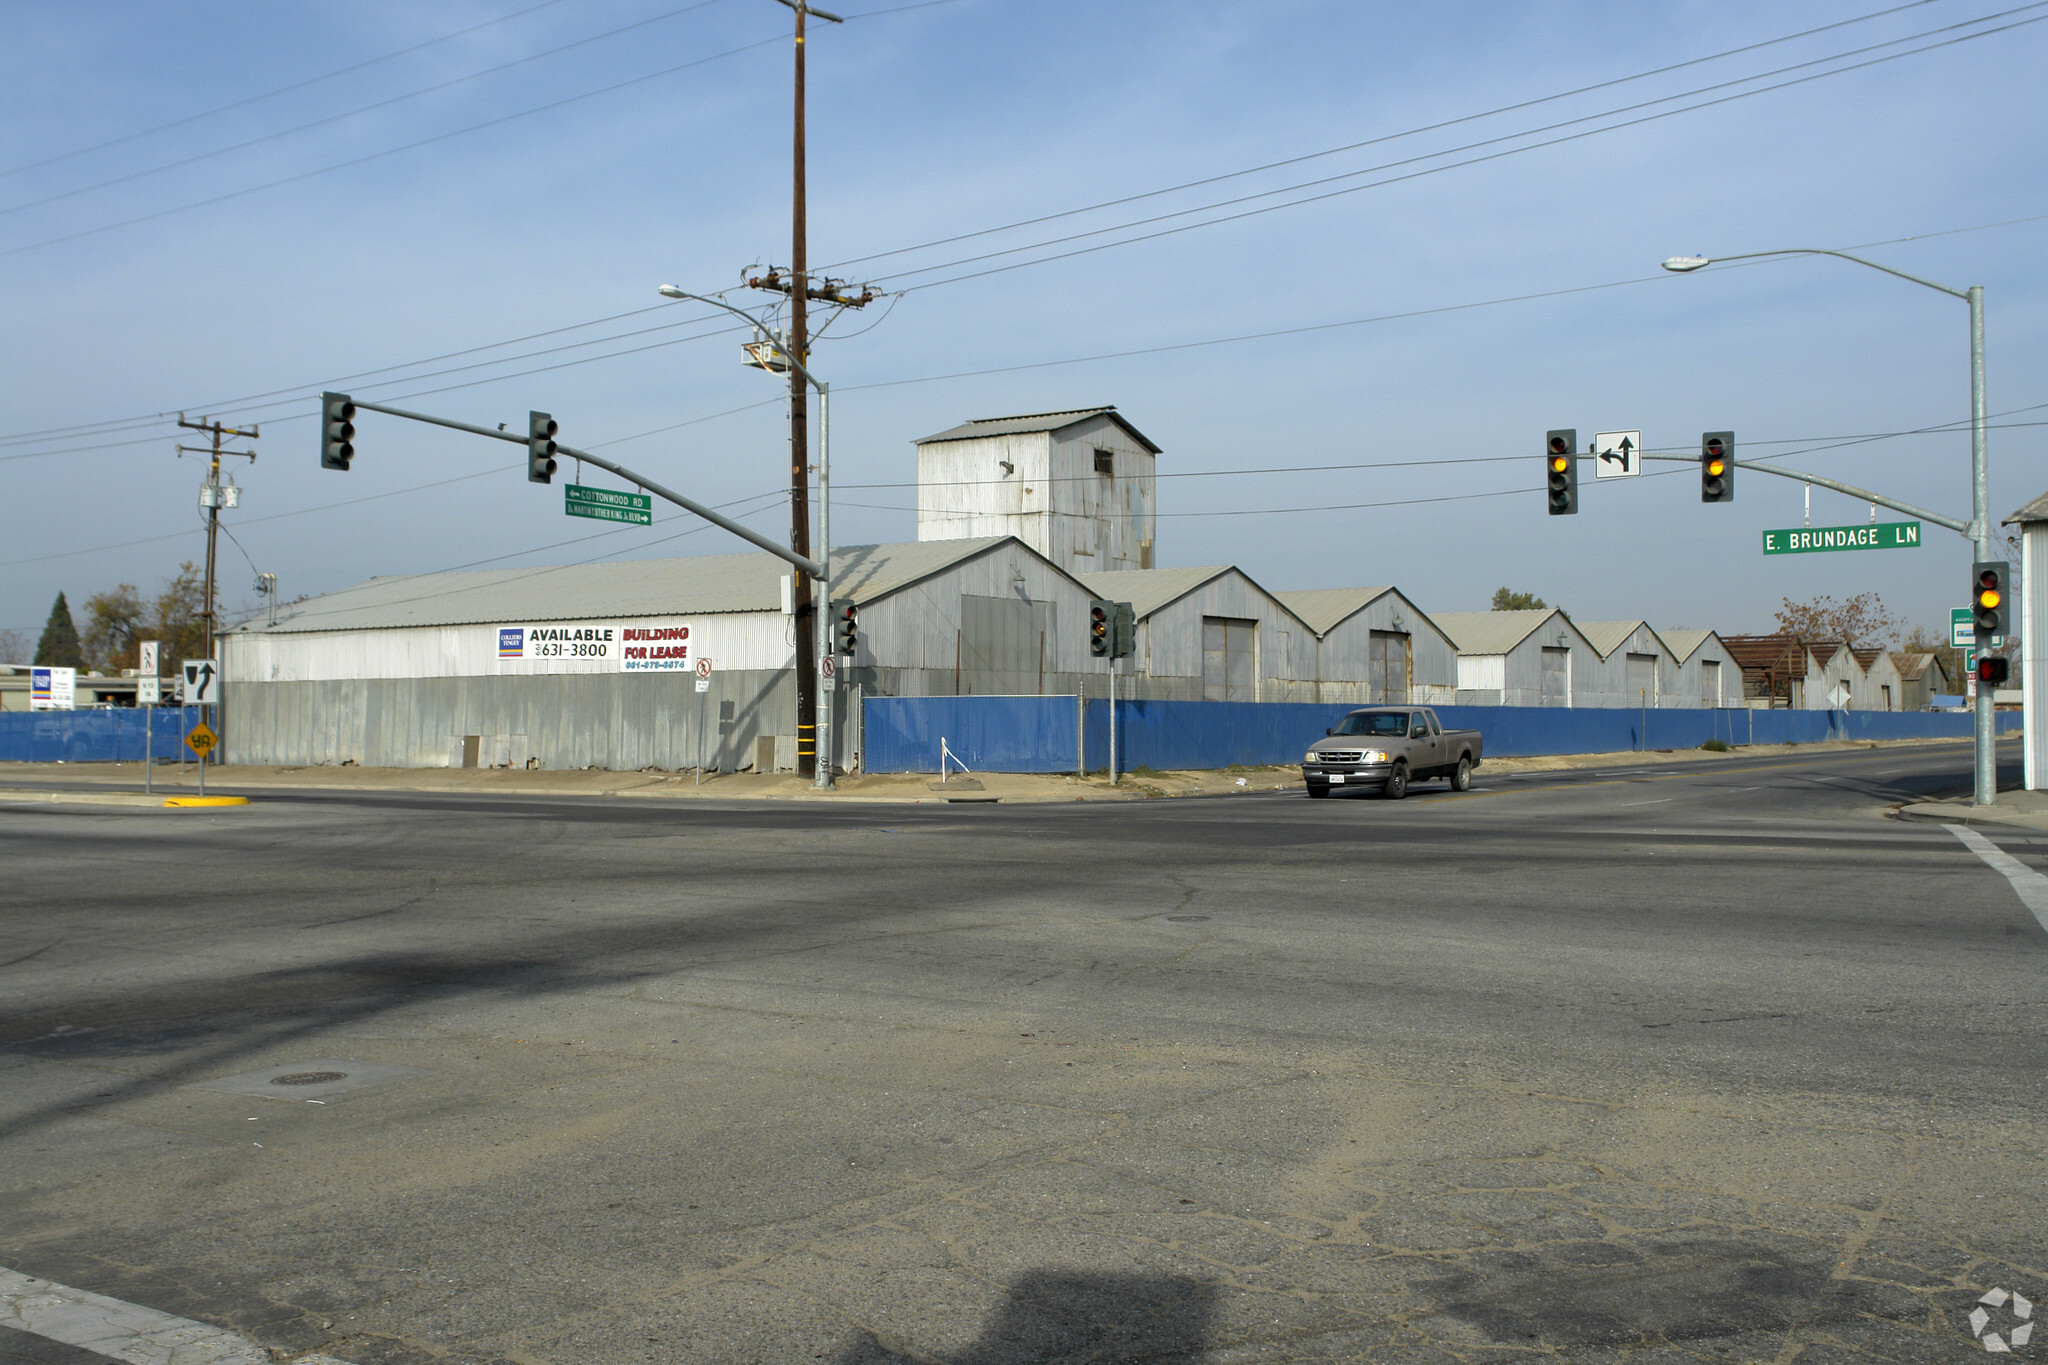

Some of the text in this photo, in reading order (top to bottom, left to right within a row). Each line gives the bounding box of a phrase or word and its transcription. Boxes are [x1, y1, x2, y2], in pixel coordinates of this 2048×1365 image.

[581, 490, 643, 507] COTTONWOOD RD
[1766, 526, 1917, 550] E. BRUNDAGE LN
[529, 629, 613, 641] AVAILABLE
[623, 627, 689, 641] BUILDING
[624, 646, 687, 659] FOR LEASE
